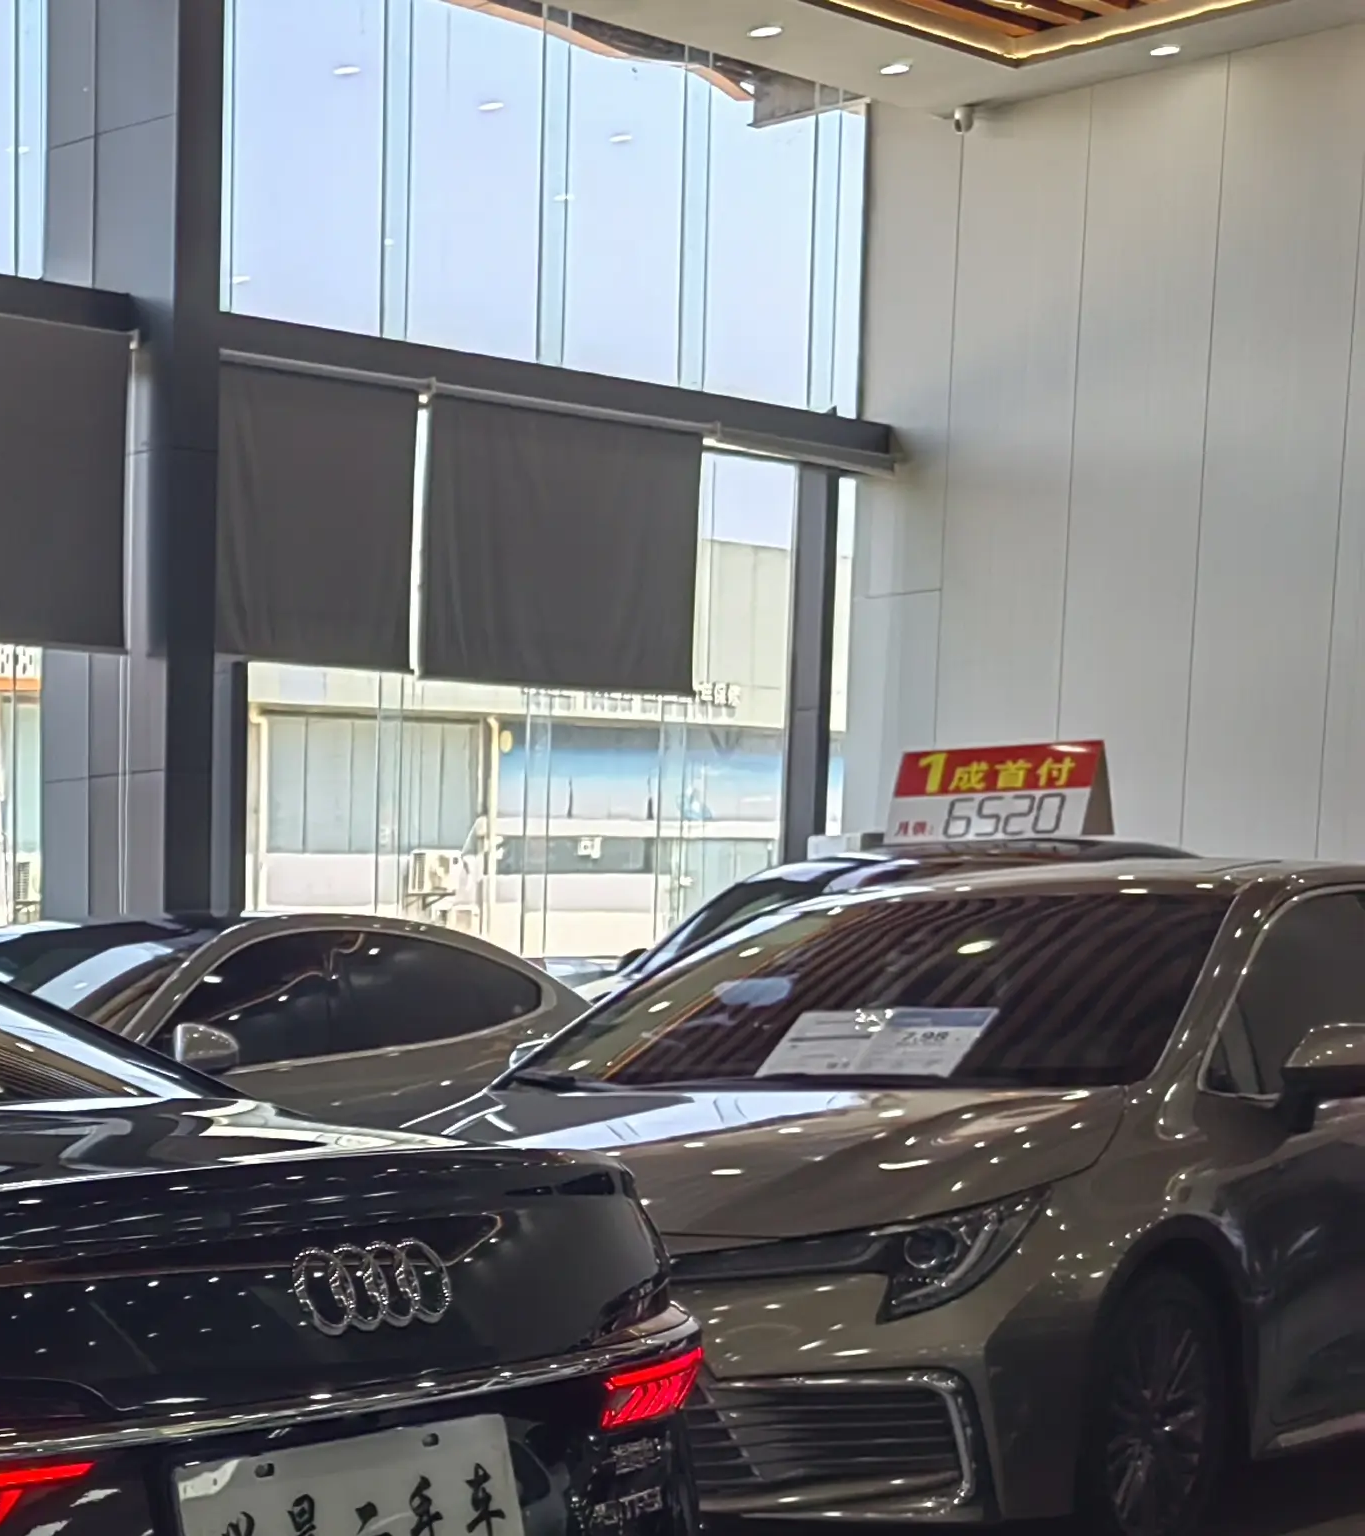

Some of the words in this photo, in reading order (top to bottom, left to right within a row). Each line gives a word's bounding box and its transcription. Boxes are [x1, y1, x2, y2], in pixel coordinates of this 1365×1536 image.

[918, 752, 1076, 794] 1成首付
[942, 792, 1067, 839] 6520
